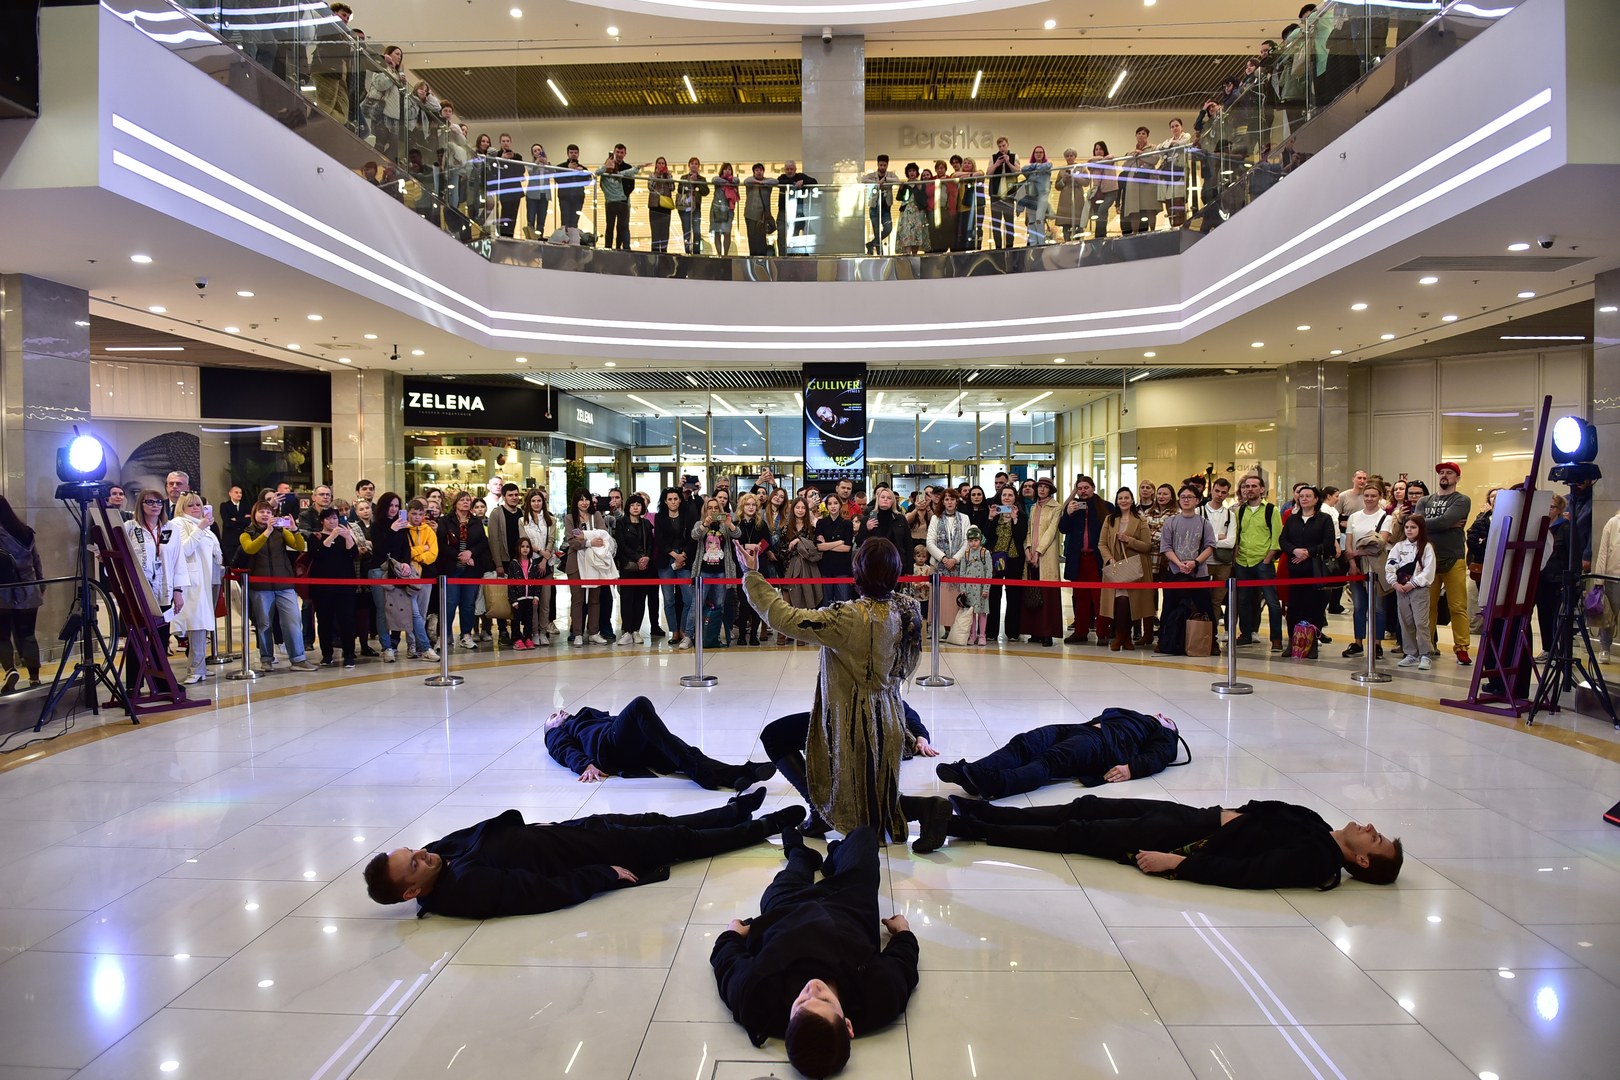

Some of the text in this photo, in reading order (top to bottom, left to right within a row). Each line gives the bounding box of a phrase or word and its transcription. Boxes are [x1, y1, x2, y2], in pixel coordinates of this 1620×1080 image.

[898, 125, 994, 150] Bershka
[807, 380, 860, 390] GULLIVER
[408, 391, 485, 411] ZELENA
[576, 408, 594, 425] ZELENA
